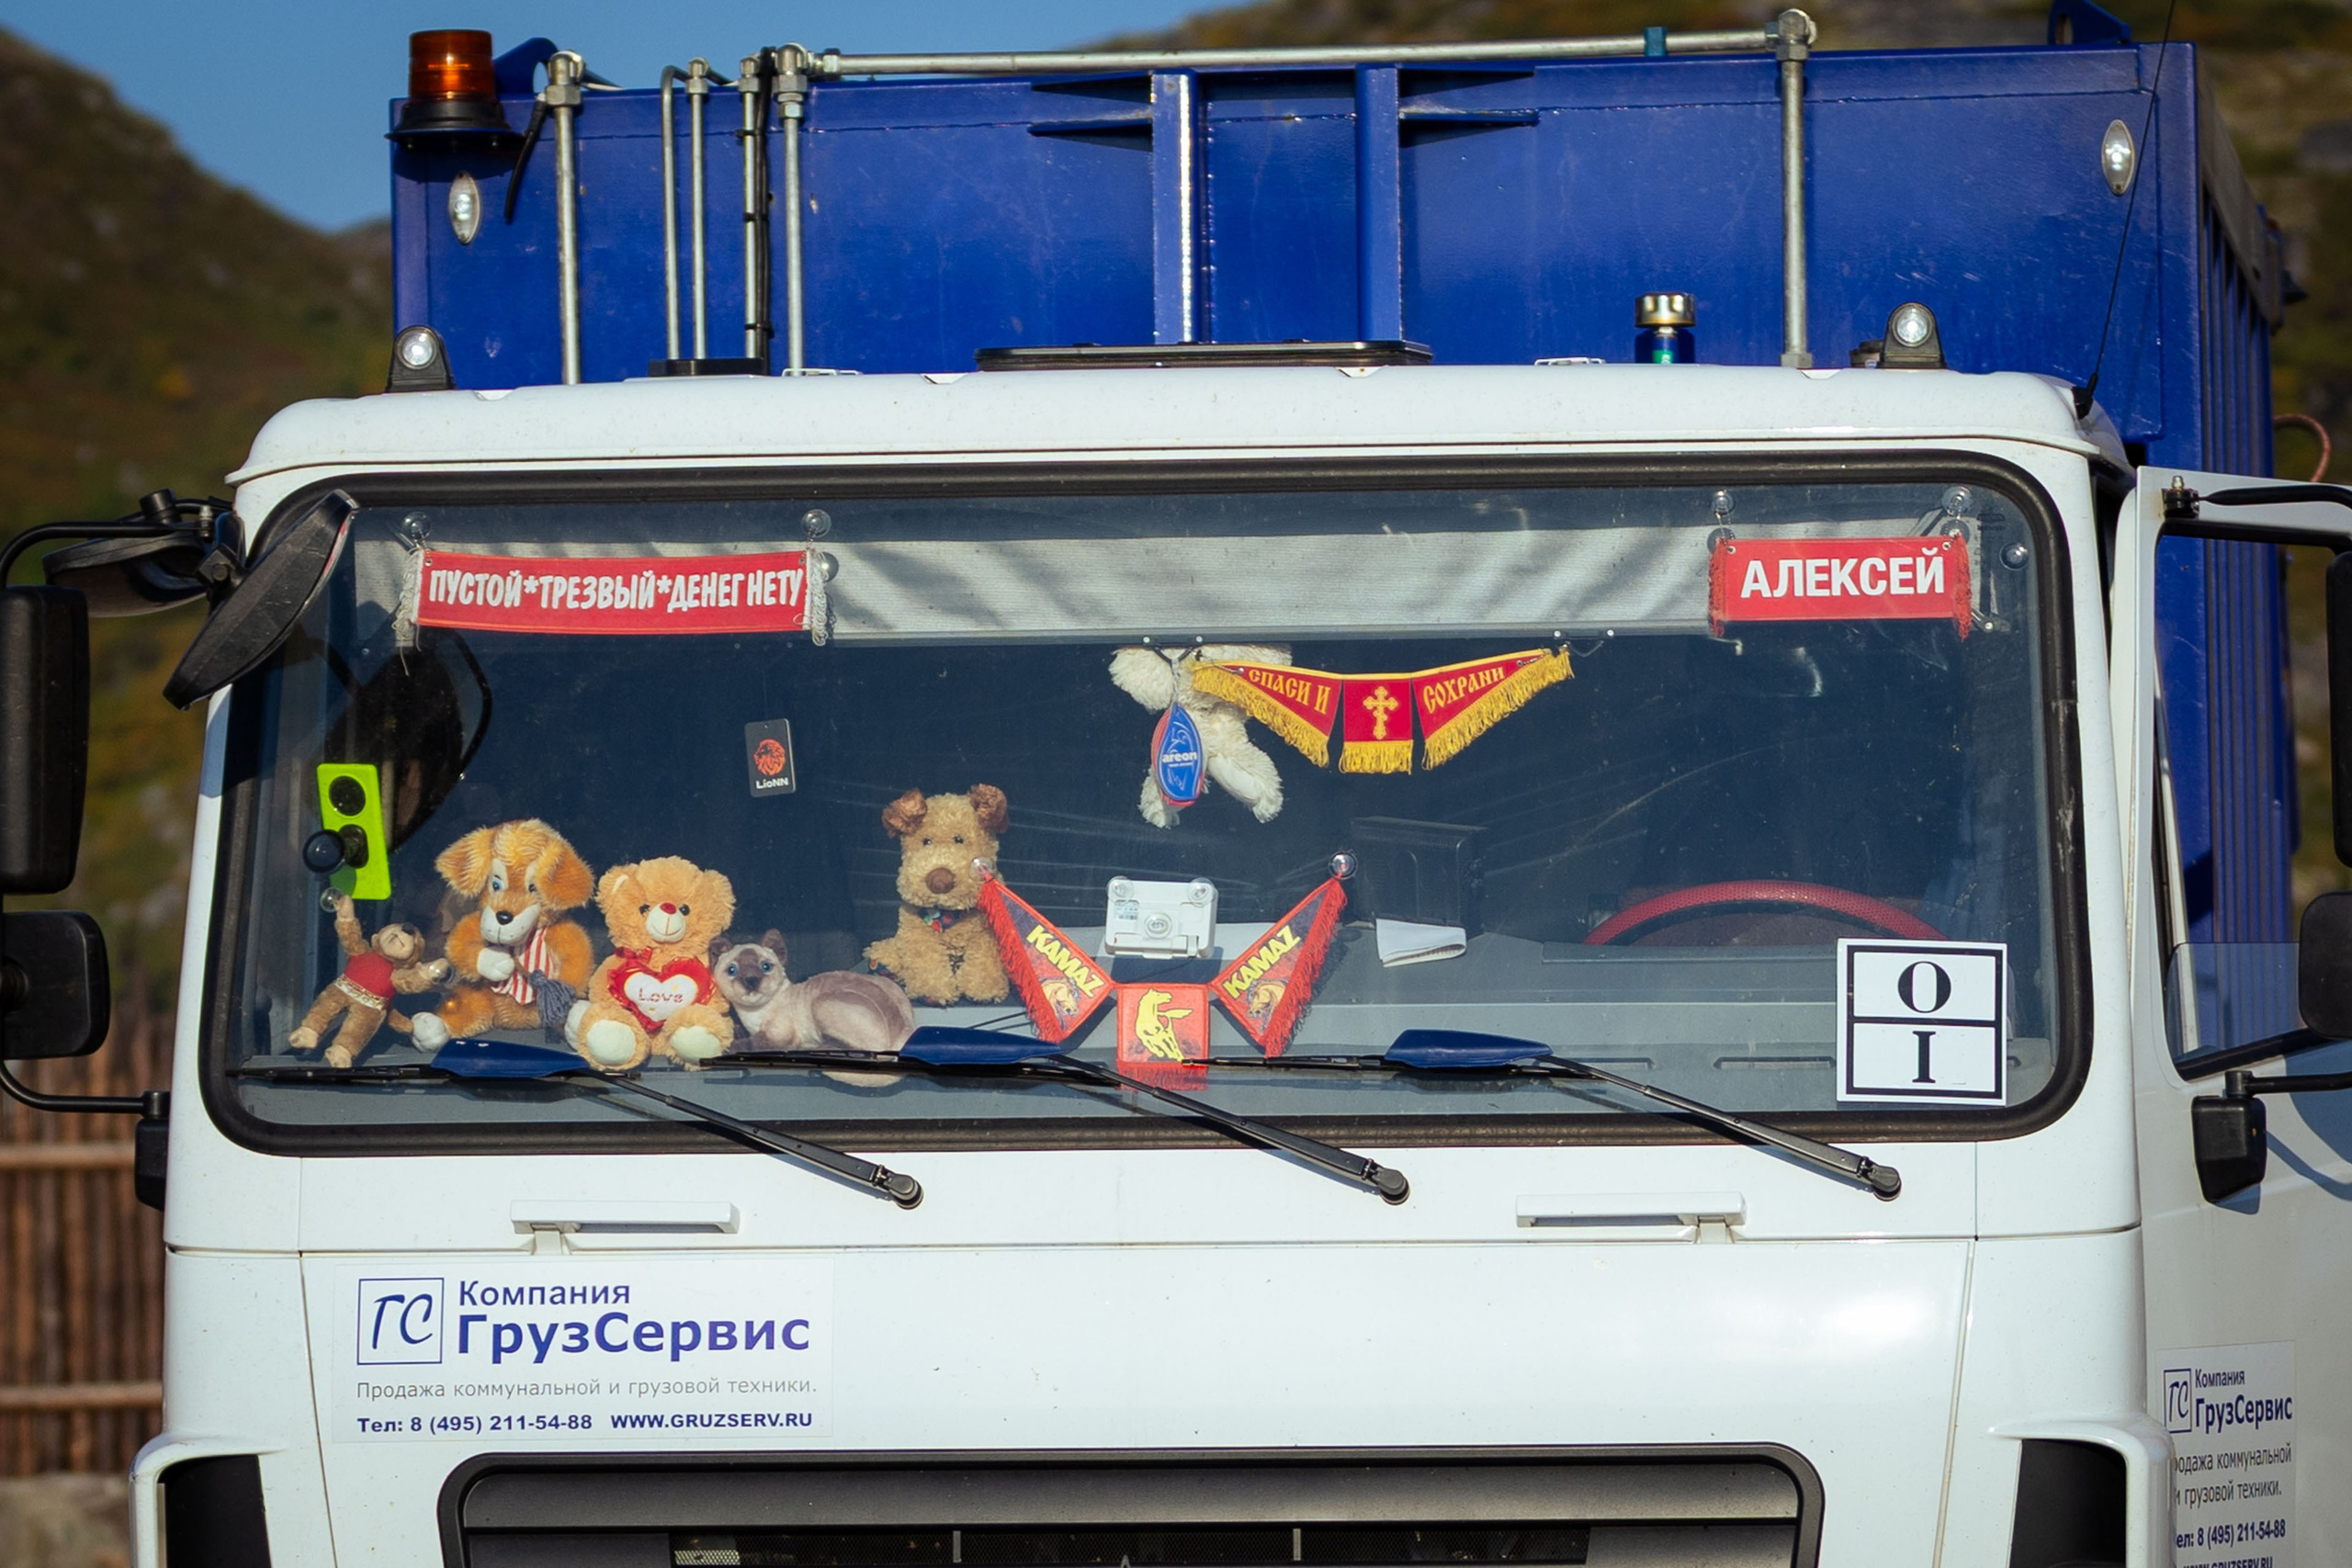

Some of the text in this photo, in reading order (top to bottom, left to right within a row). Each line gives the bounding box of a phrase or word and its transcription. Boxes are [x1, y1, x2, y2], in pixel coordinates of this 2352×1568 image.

[747, 568, 804, 606] НЕТУ
[1740, 547, 1945, 598] АЛЕКСЕЙ
[1249, 669, 1331, 715] СПАСИ И
[1422, 667, 1505, 714] СОХРАНИ
[1161, 751, 1198, 763] areon
[1025, 924, 1105, 998] KAMAZ
[1222, 924, 1302, 999] KAMAZ
[638, 987, 684, 1003] Love
[459, 1280, 630, 1306] Компания
[458, 1312, 809, 1365] ГрузСервис
[356, 1377, 817, 1402] Продажа коммунальной и грузовой техники.
[2194, 1368, 2245, 1388] Компания
[356, 1413, 813, 1435] Тел: 8 (495) 211-54-88 WWW.GRUZSERV.RU
[2195, 1394, 2292, 1434] ГрузСервис
[2217, 1441, 2291, 1472] коммунальной
[2184, 1479, 2233, 1509] грузовой
[2237, 1481, 2282, 1499] техники.
[2176, 1518, 2286, 1551] ел: 8 (495) 211-54-88
